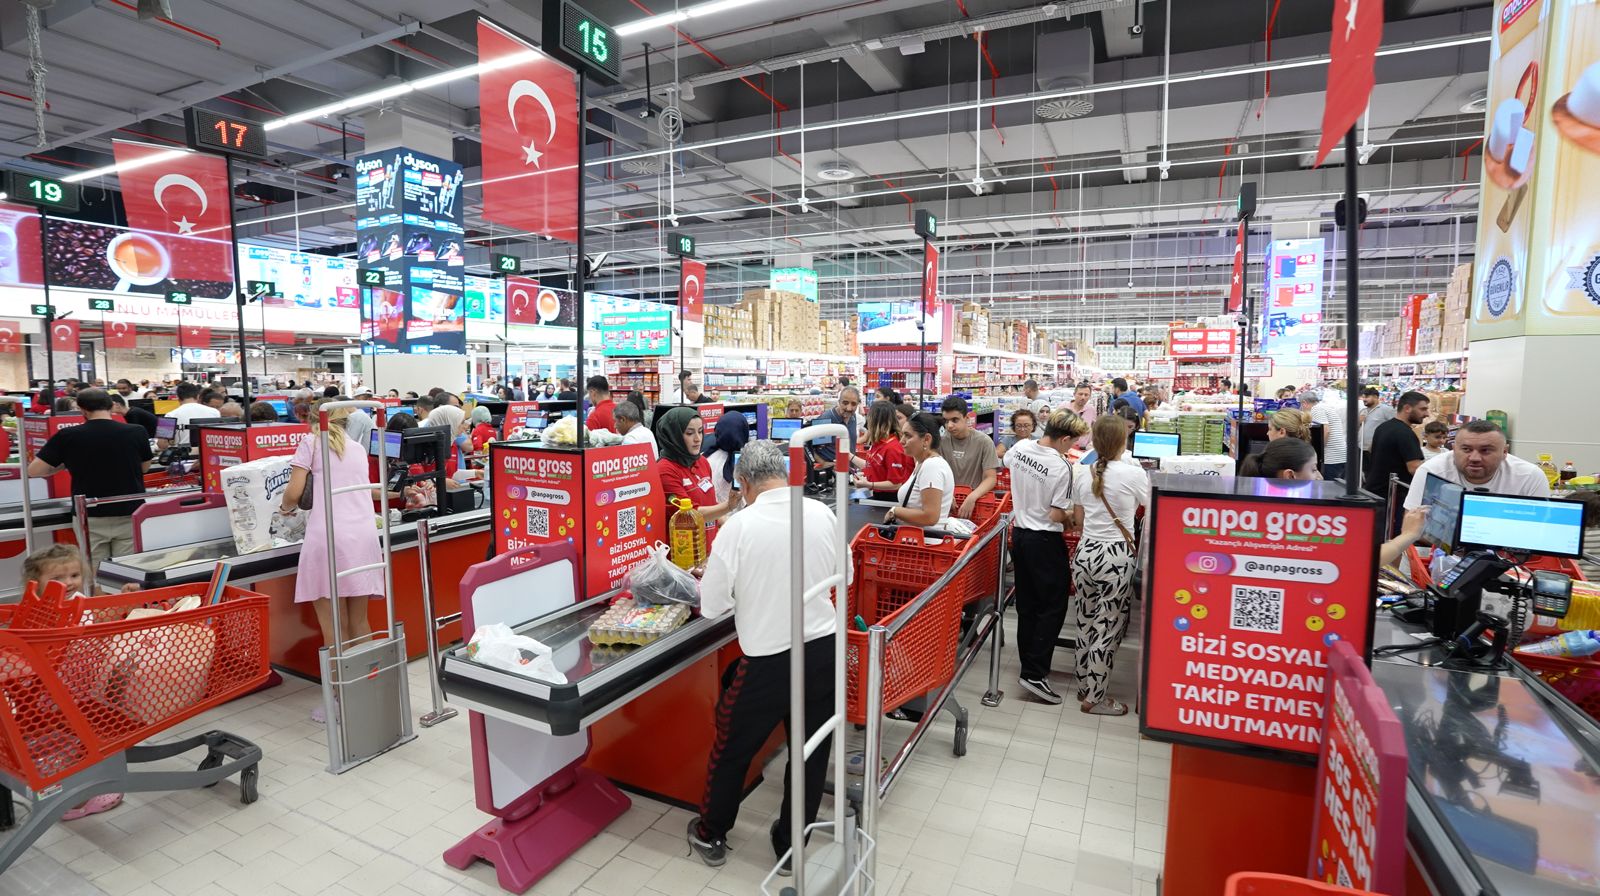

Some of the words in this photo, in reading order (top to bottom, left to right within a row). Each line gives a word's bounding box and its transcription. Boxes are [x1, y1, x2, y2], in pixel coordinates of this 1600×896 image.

[579, 20, 608, 62] 15
[215, 120, 248, 148] 17
[356, 159, 384, 175] dyson
[403, 153, 440, 174] dyson
[29, 180, 62, 202] 19
[680, 237, 692, 253] 18
[501, 257, 516, 270] 20
[365, 272, 381, 284] 22
[255, 283, 271, 295] 24
[95, 301, 110, 310] 28
[172, 293, 187, 303] 26
[206, 434, 223, 447] anpa
[224, 435, 243, 448] gross
[255, 434, 287, 447] anpa
[504, 455, 536, 475] anpa
[538, 458, 573, 478] gross
[592, 459, 621, 477] anpa
[622, 453, 649, 475] gross
[530, 490, 564, 501] @anpagross
[618, 486, 646, 498] @anpagross
[1182, 506, 1258, 535] anpa
[1265, 511, 1348, 541] gross
[609, 543, 623, 555] BİZİ
[623, 537, 647, 550] SOSYAL
[611, 549, 647, 566] MEDYADAN
[608, 565, 627, 579] TAKİP
[1244, 560, 1323, 576] @anpagross
[1181, 632, 1227, 656] BİZİ
[1232, 641, 1328, 668] SOSYAL
[1185, 661, 1325, 694] MEDYADAN
[1171, 682, 1240, 706] TAKİP
[1245, 694, 1325, 719] ETMEY
[1178, 707, 1323, 744] UNUTMAYIN
[1327, 737, 1352, 801] 365
